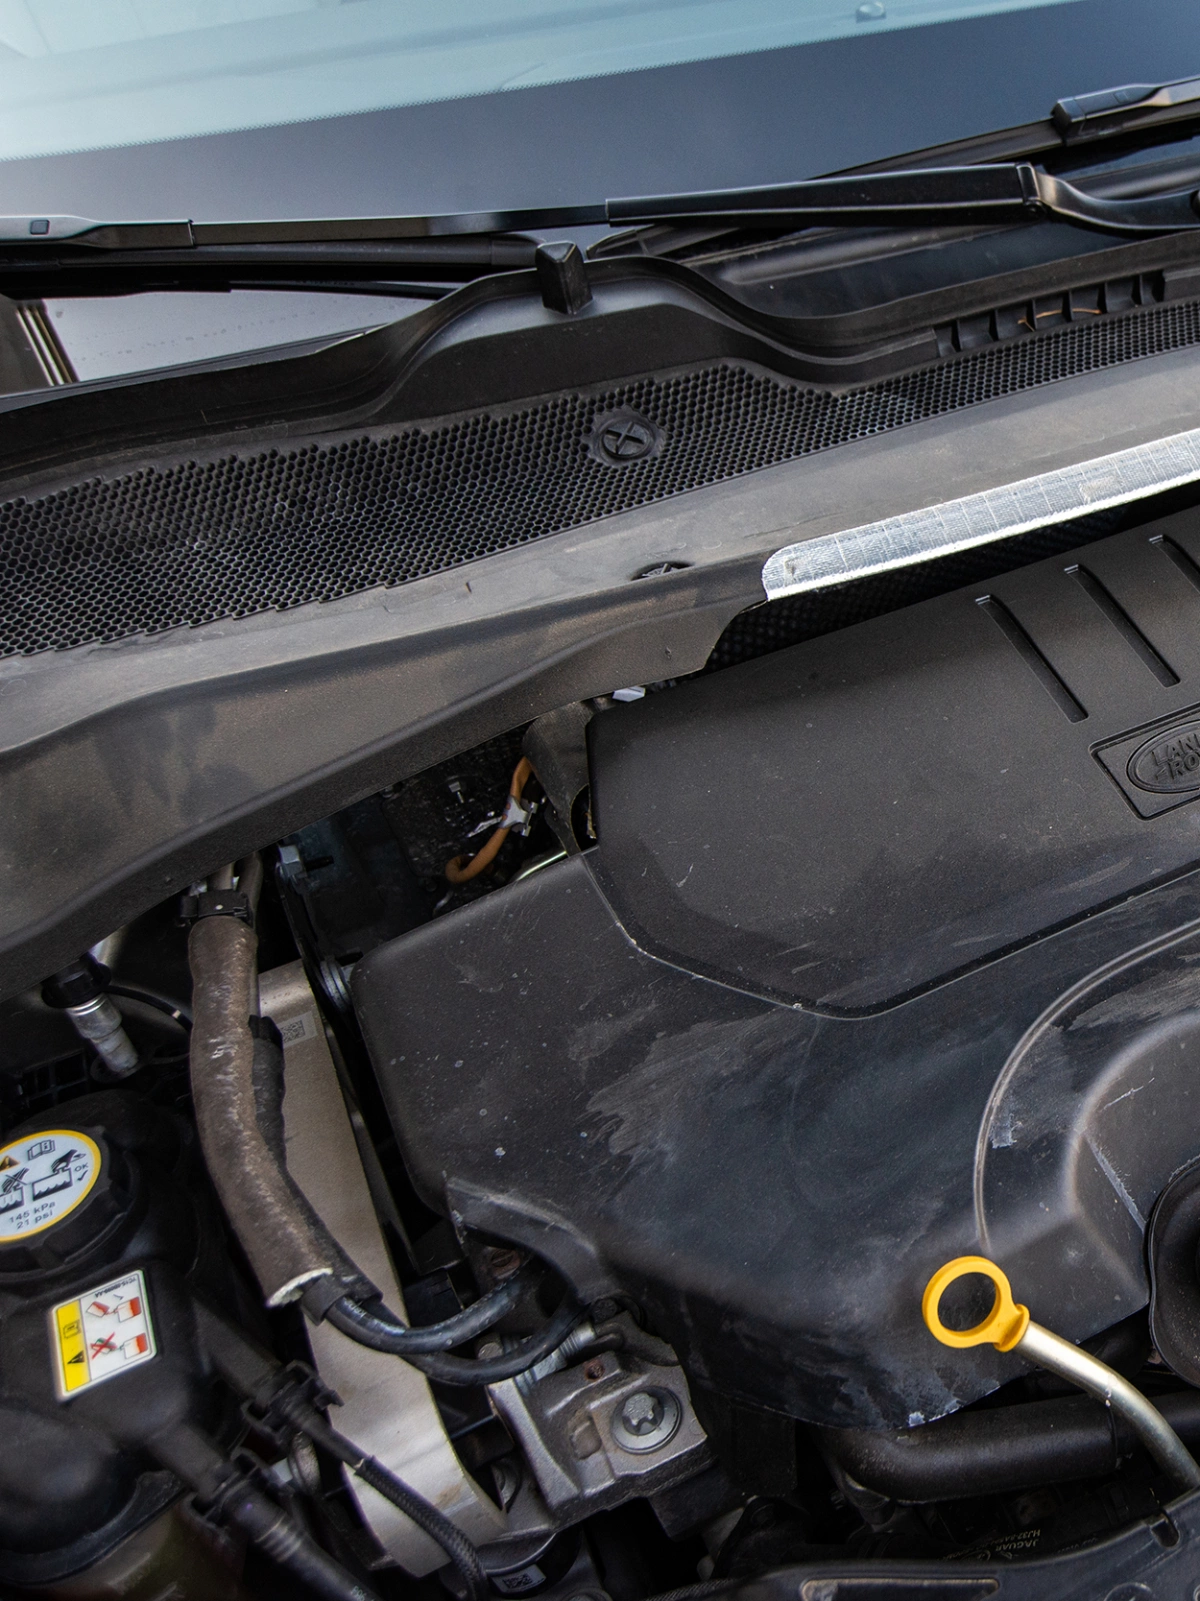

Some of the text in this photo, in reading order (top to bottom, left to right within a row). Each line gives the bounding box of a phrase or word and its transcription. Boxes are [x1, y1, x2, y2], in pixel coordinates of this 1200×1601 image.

[74, 1162, 89, 1173] OK
[9, 1201, 56, 1224] 145 kPa
[16, 1211, 53, 1230] 21 psi
[995, 1539, 1039, 1552] JAGUAR
